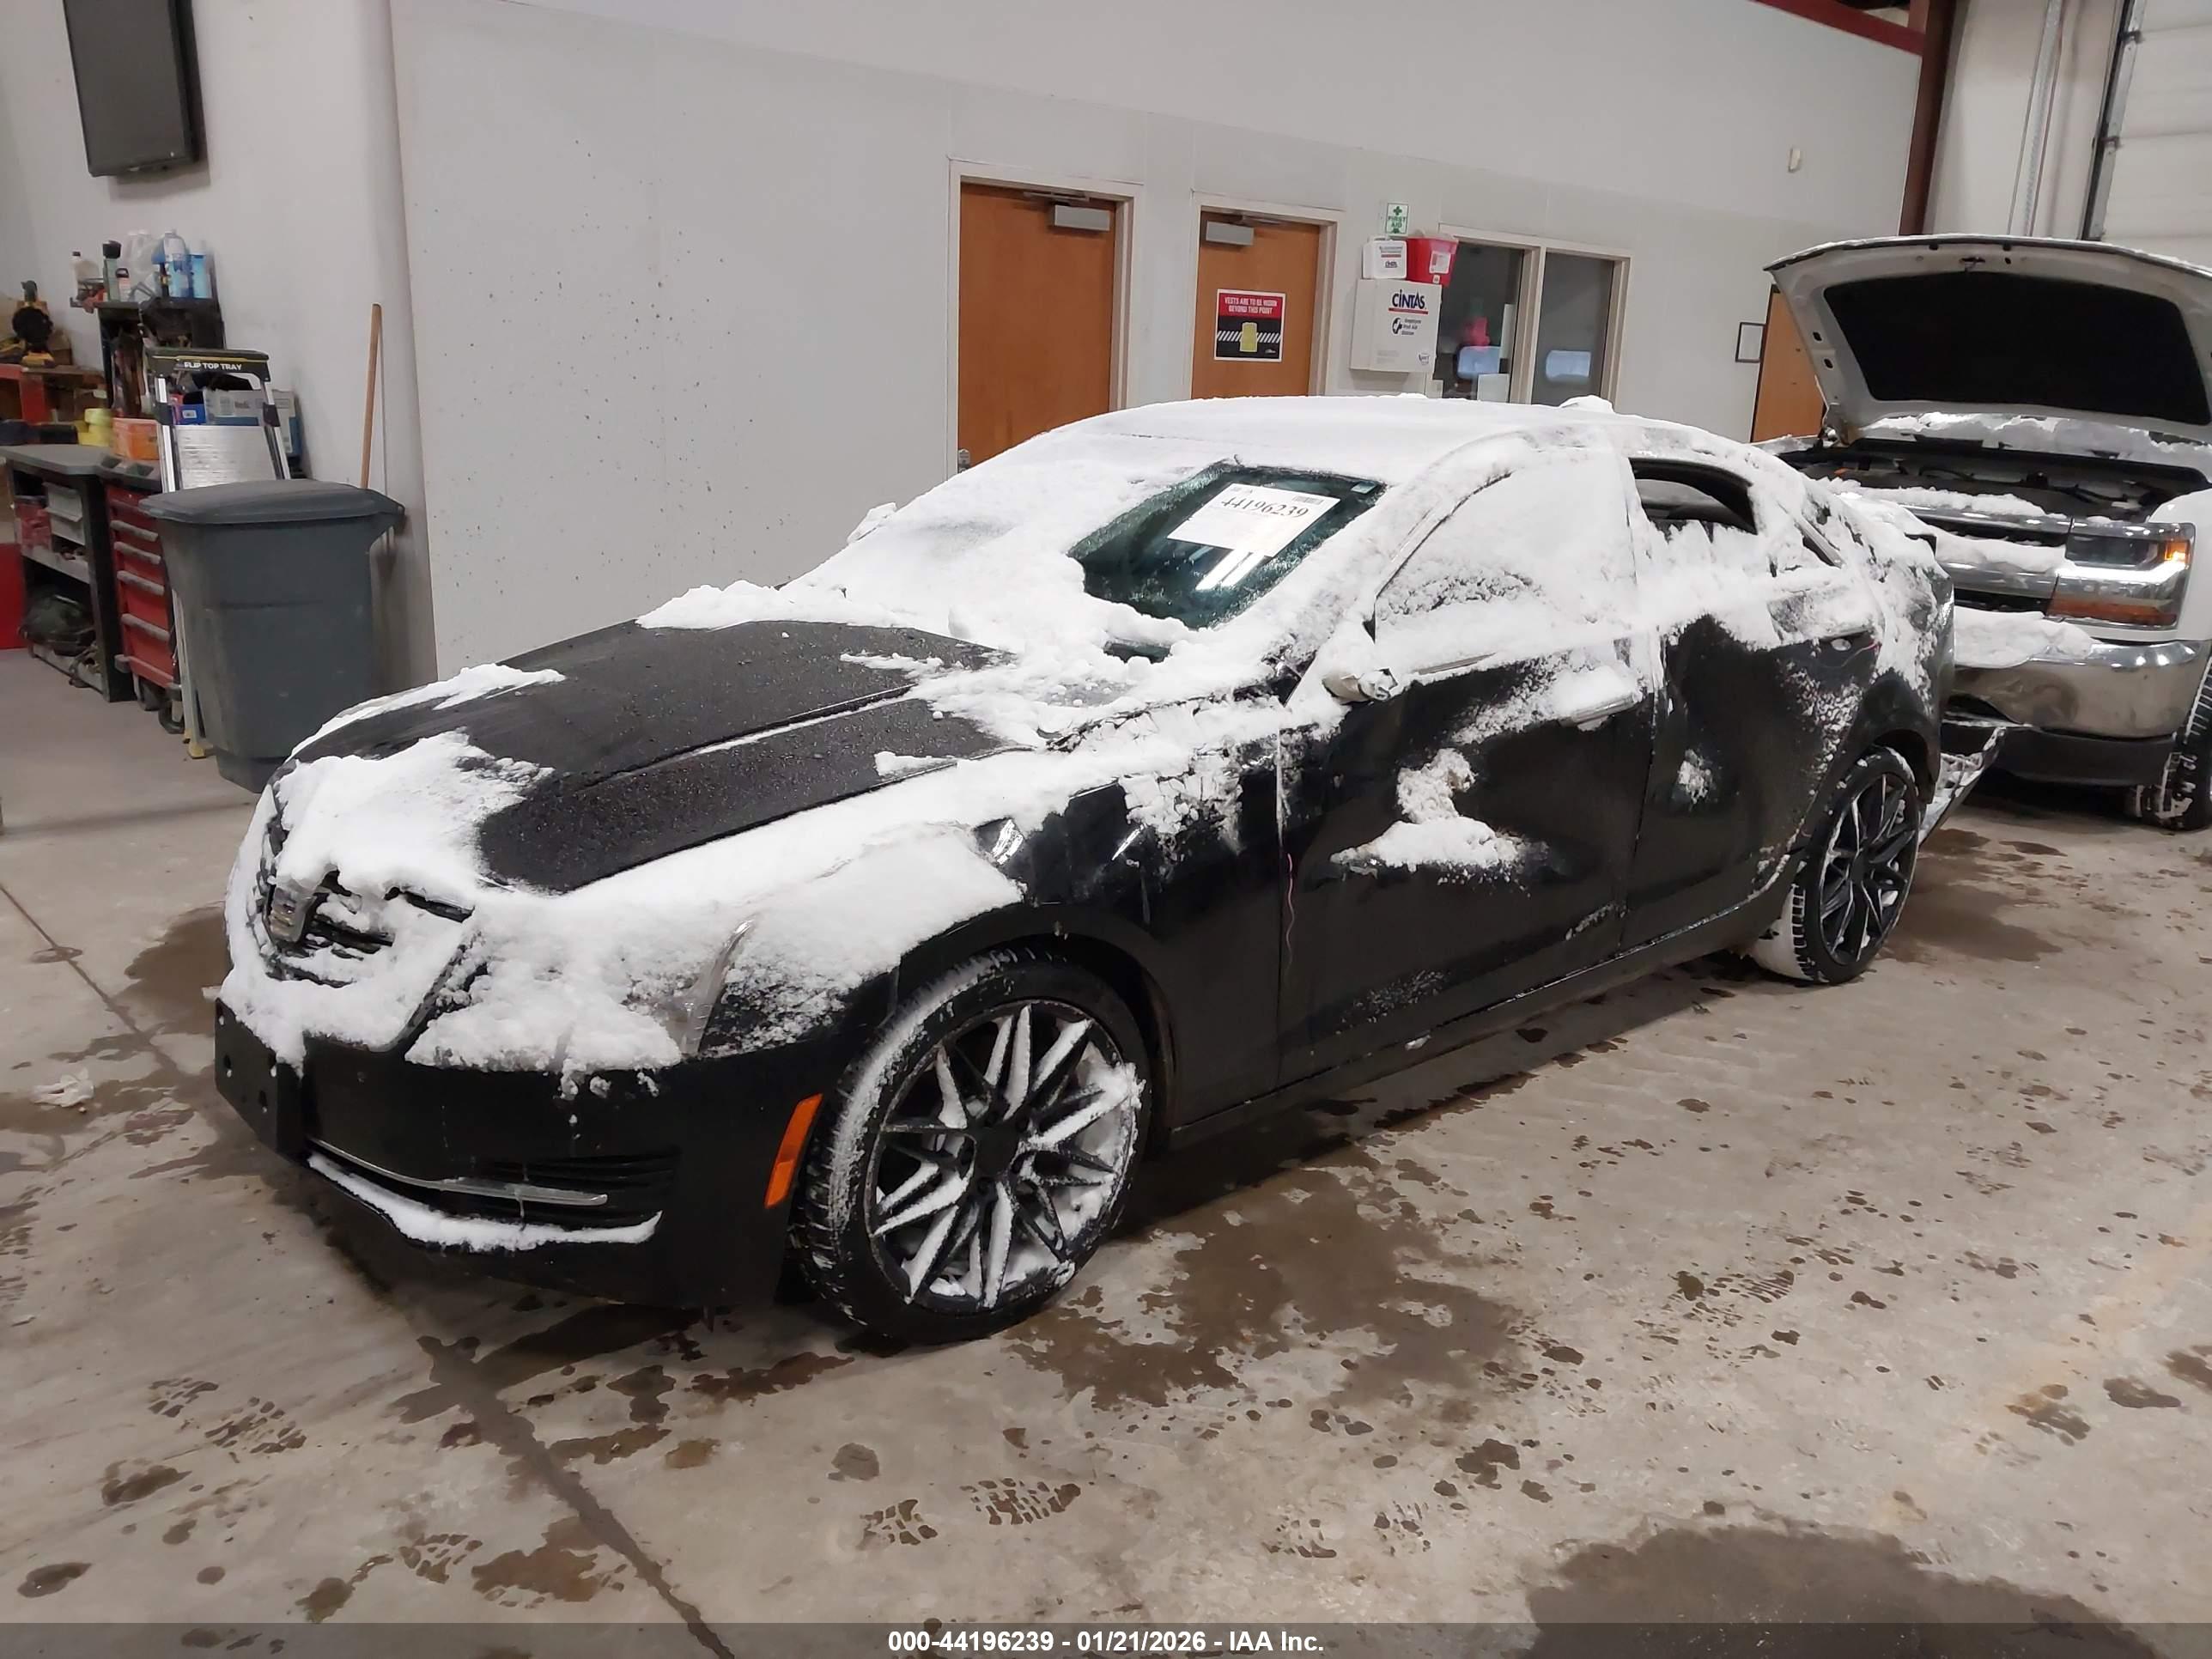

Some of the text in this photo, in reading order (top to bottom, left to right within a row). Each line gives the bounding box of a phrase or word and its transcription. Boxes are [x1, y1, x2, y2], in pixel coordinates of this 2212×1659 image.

[1224, 296, 1239, 305] VESTS
[1239, 297, 1249, 306] ARE
[1248, 306, 1259, 314] THIS
[1258, 307, 1273, 315] POINT
[1221, 495, 1310, 519] 44196239
